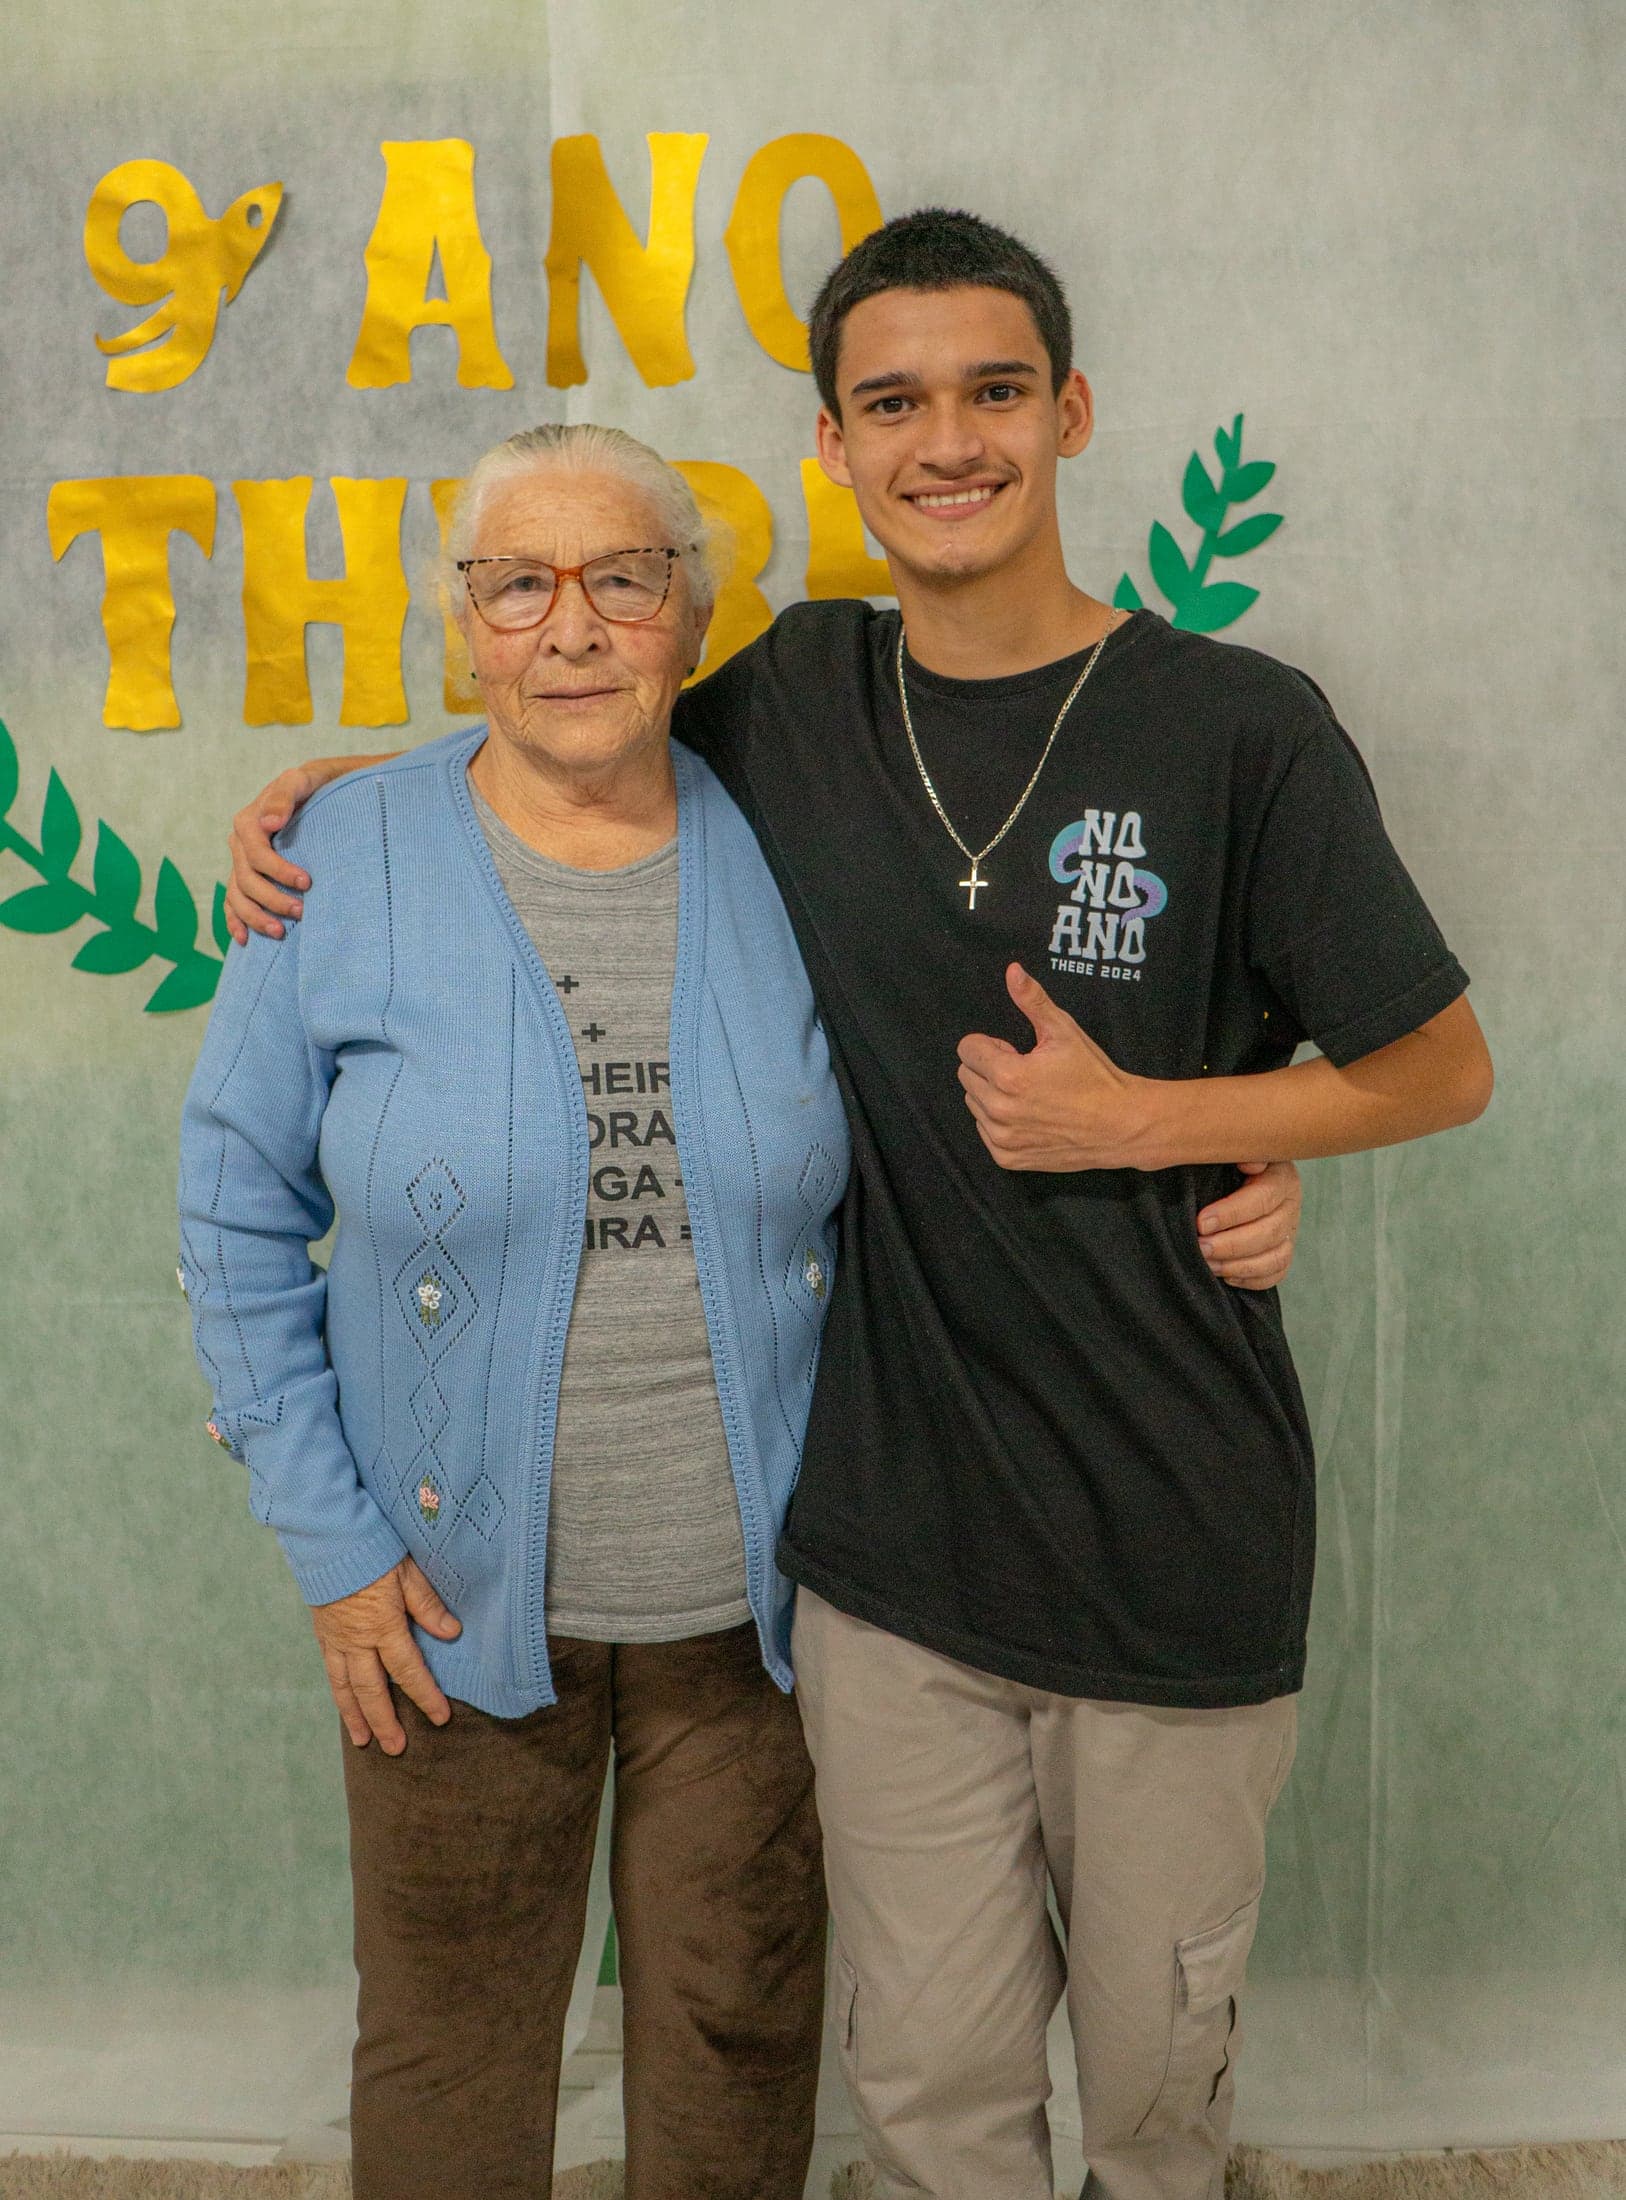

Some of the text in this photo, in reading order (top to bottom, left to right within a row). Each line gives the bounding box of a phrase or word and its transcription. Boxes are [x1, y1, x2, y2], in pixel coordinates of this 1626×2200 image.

[346, 132, 884, 390] ANO
[1078, 809, 1147, 859] NO
[1070, 860, 1142, 909] NO
[1048, 905, 1147, 964] ANO
[1050, 957, 1142, 982] THEBE 2024
